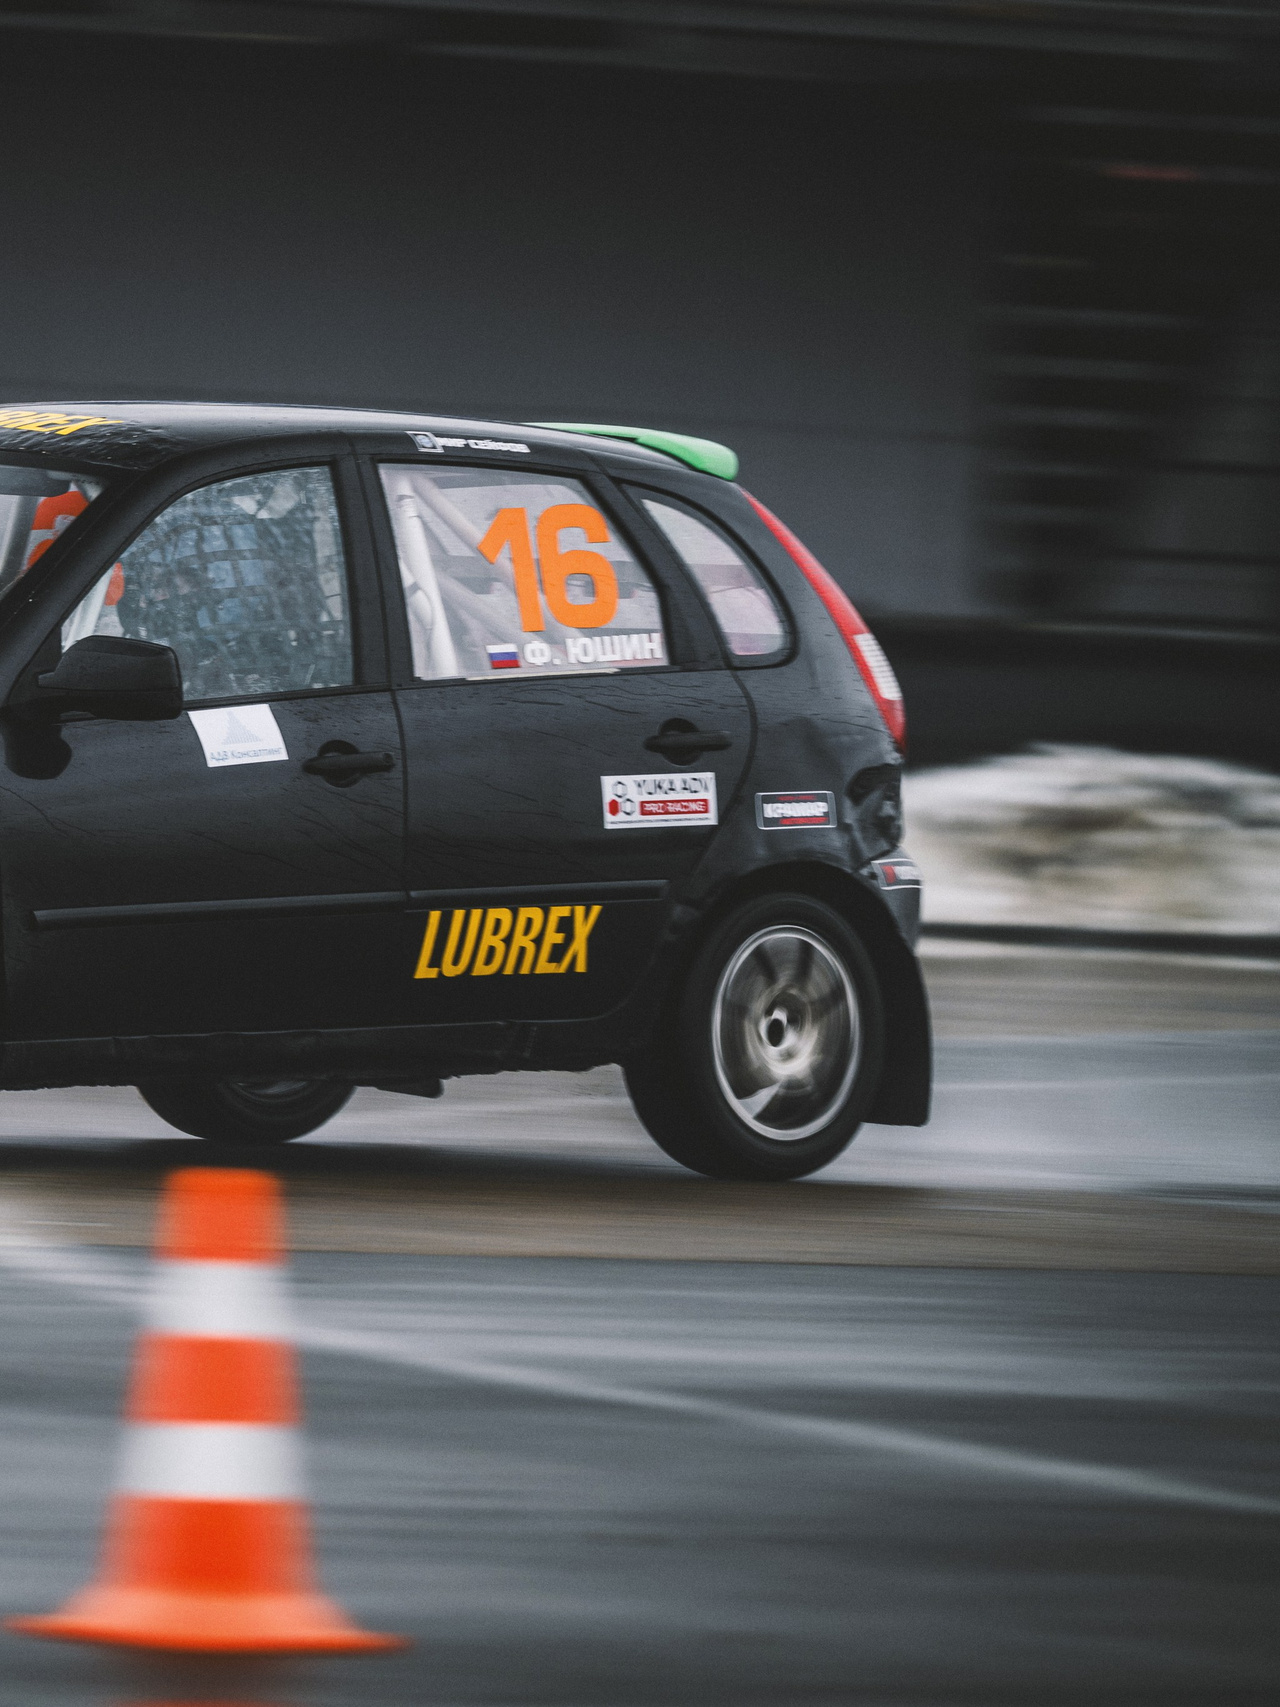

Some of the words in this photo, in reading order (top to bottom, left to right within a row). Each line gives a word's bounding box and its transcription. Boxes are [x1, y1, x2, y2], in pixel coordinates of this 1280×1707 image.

[477, 503, 619, 632] 16
[523, 641, 562, 666] Ф.
[565, 632, 664, 664] ЮШИН
[413, 905, 604, 980] LUBREX
